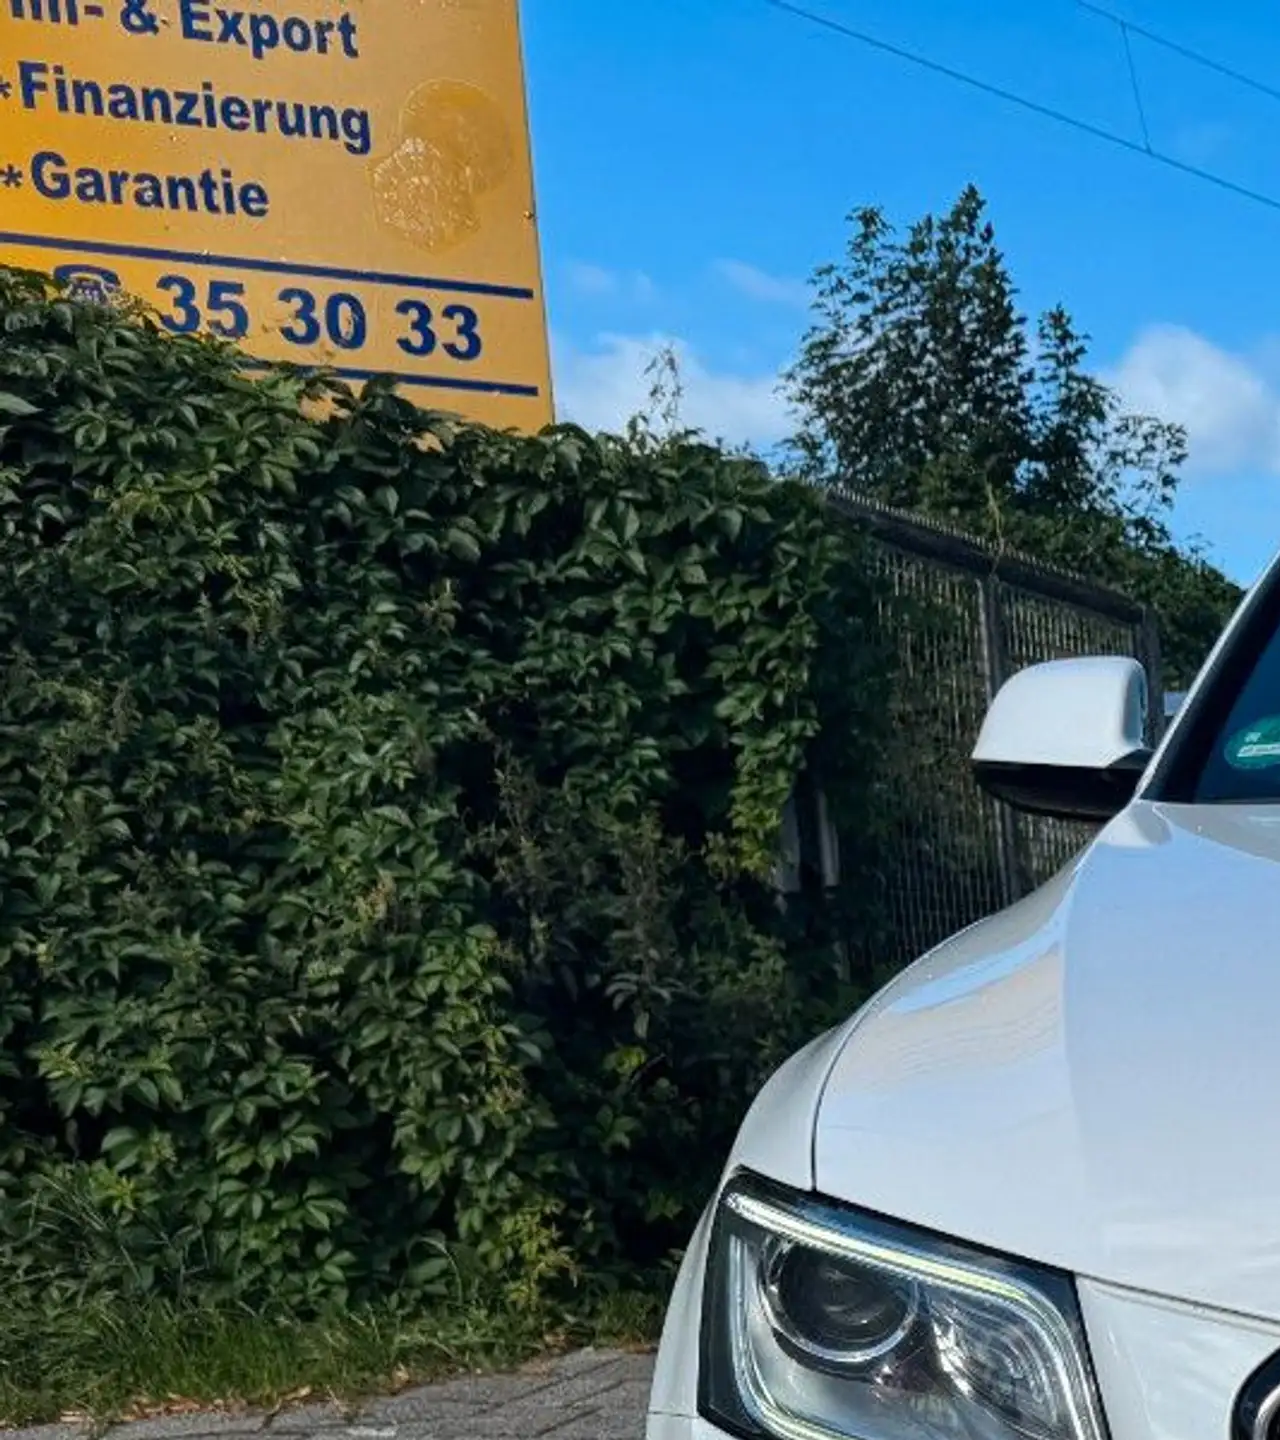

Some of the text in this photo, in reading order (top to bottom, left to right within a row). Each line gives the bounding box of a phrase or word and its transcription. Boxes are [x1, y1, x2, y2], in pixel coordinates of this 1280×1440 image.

[120, 0, 159, 35] &
[180, 0, 359, 59] Export
[17, 60, 372, 155] Finanzierung
[30, 151, 269, 218] Garantie
[156, 274, 482, 361] 35 30 33
